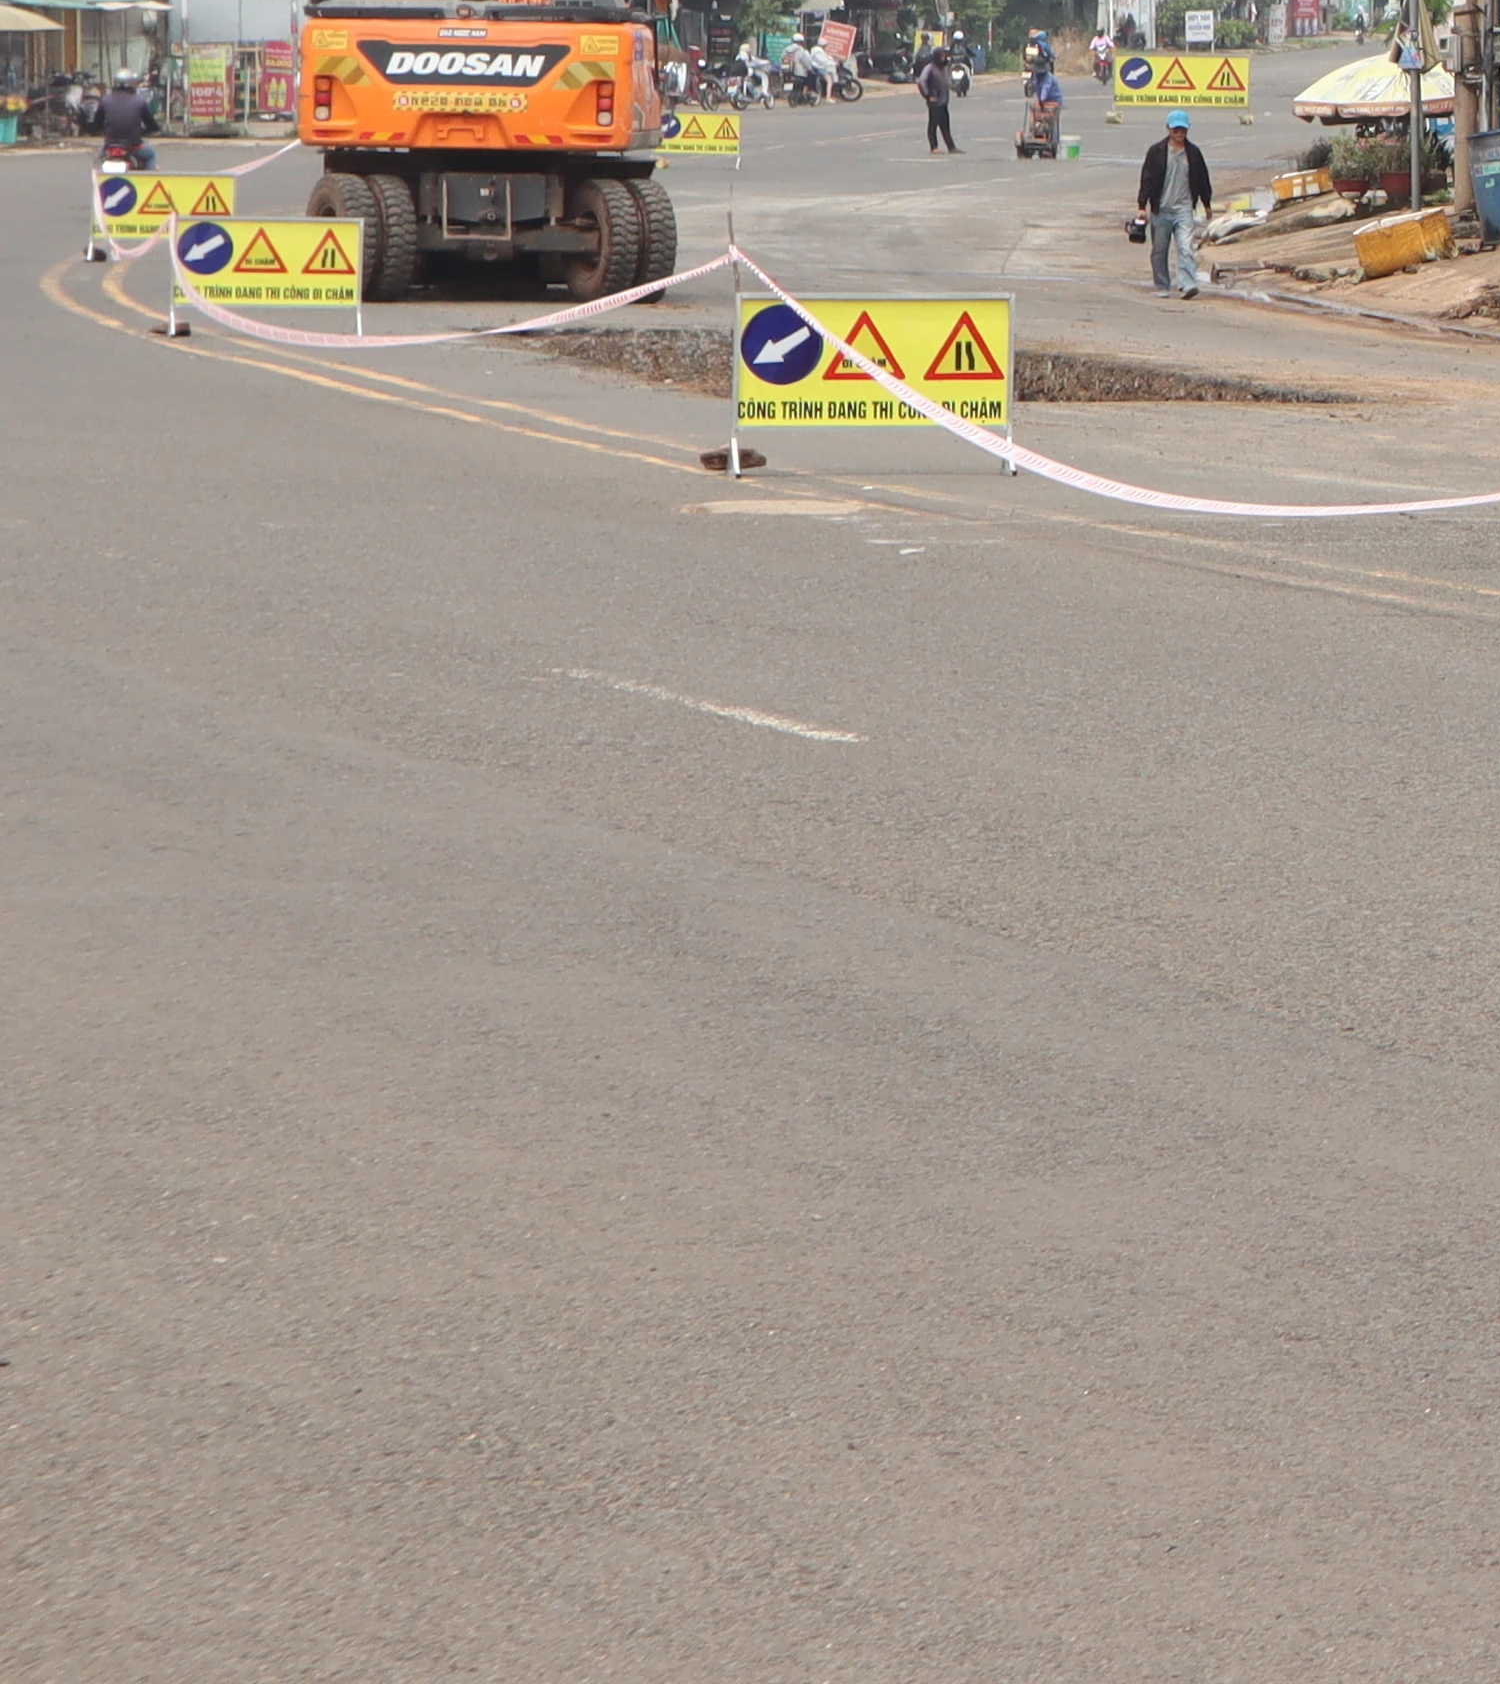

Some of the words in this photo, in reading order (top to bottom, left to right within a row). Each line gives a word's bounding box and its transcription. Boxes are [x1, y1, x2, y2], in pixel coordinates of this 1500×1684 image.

[386, 52, 545, 78] DOOSAN
[738, 398, 776, 419] CÔNG
[781, 397, 823, 419] TRÌNH
[828, 401, 867, 419] ĐANG
[872, 401, 893, 419] THI
[961, 397, 1002, 423] CHẬM
